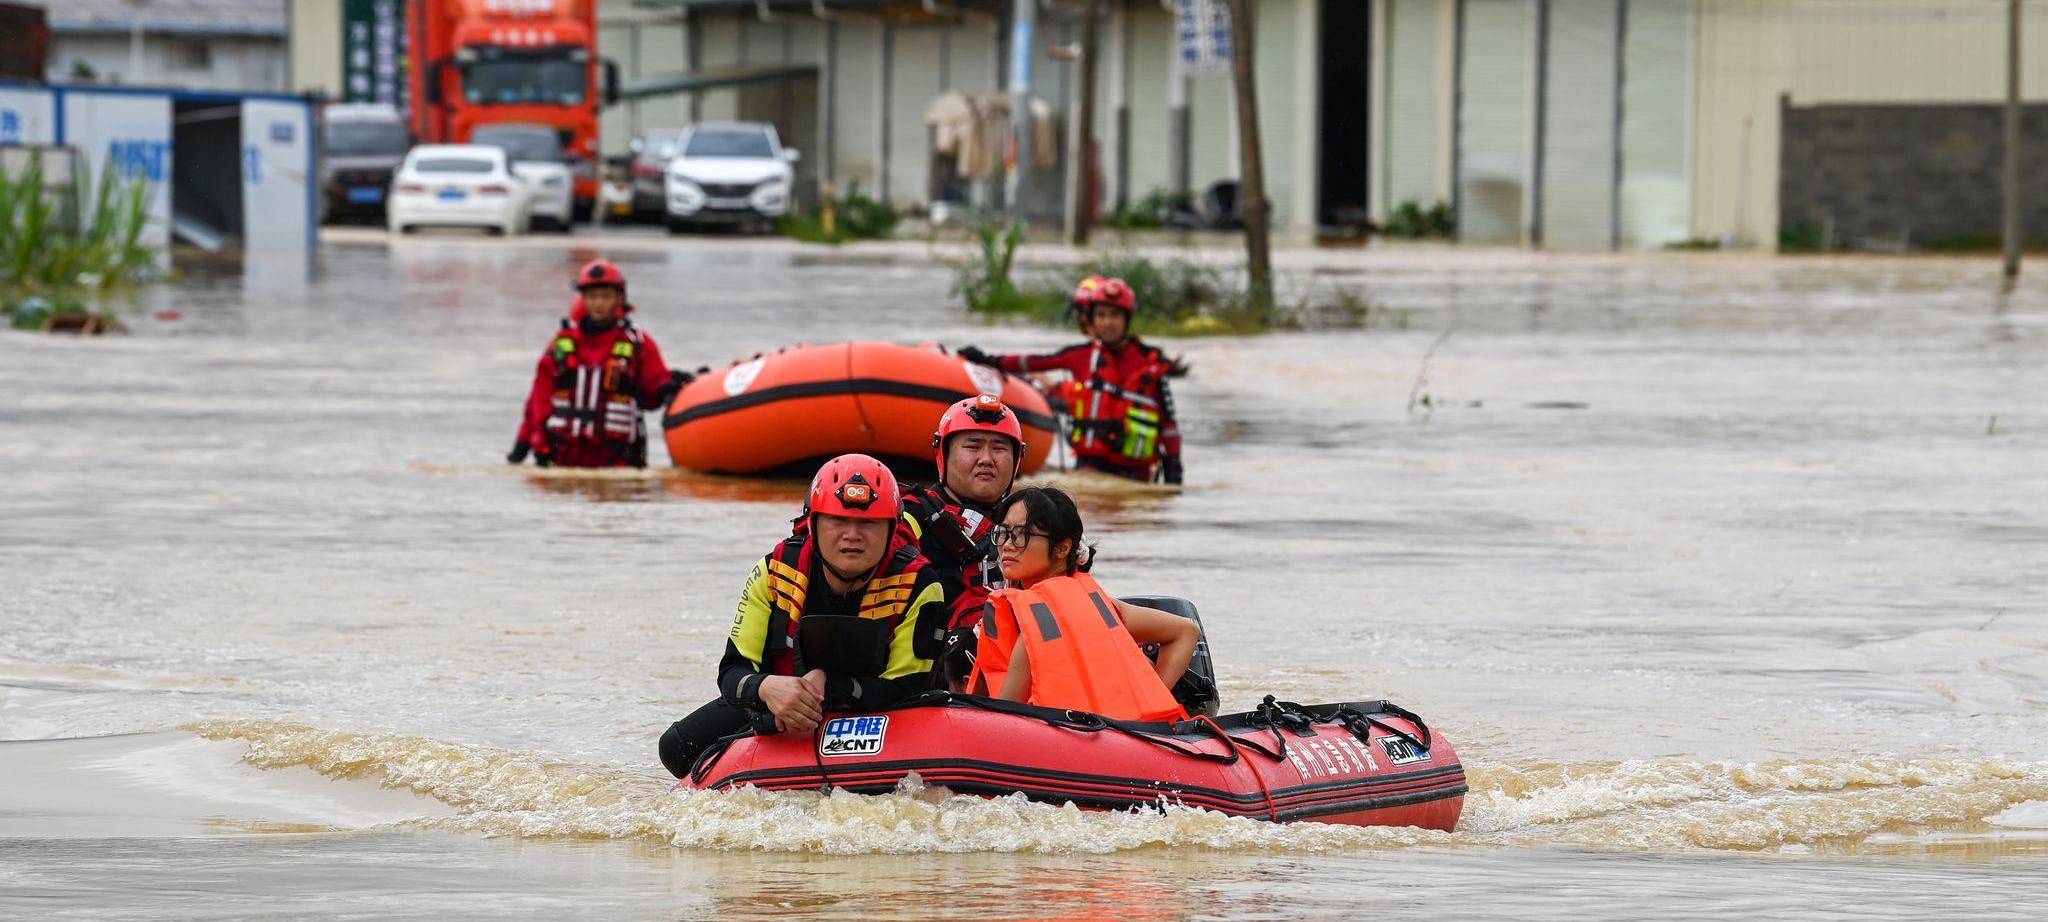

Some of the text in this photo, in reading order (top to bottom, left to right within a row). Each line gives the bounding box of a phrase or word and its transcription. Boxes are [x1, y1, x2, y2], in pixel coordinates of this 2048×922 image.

[731, 565, 762, 638] RESCUE
[827, 717, 884, 737] 中艇
[844, 738, 878, 750] CNT
